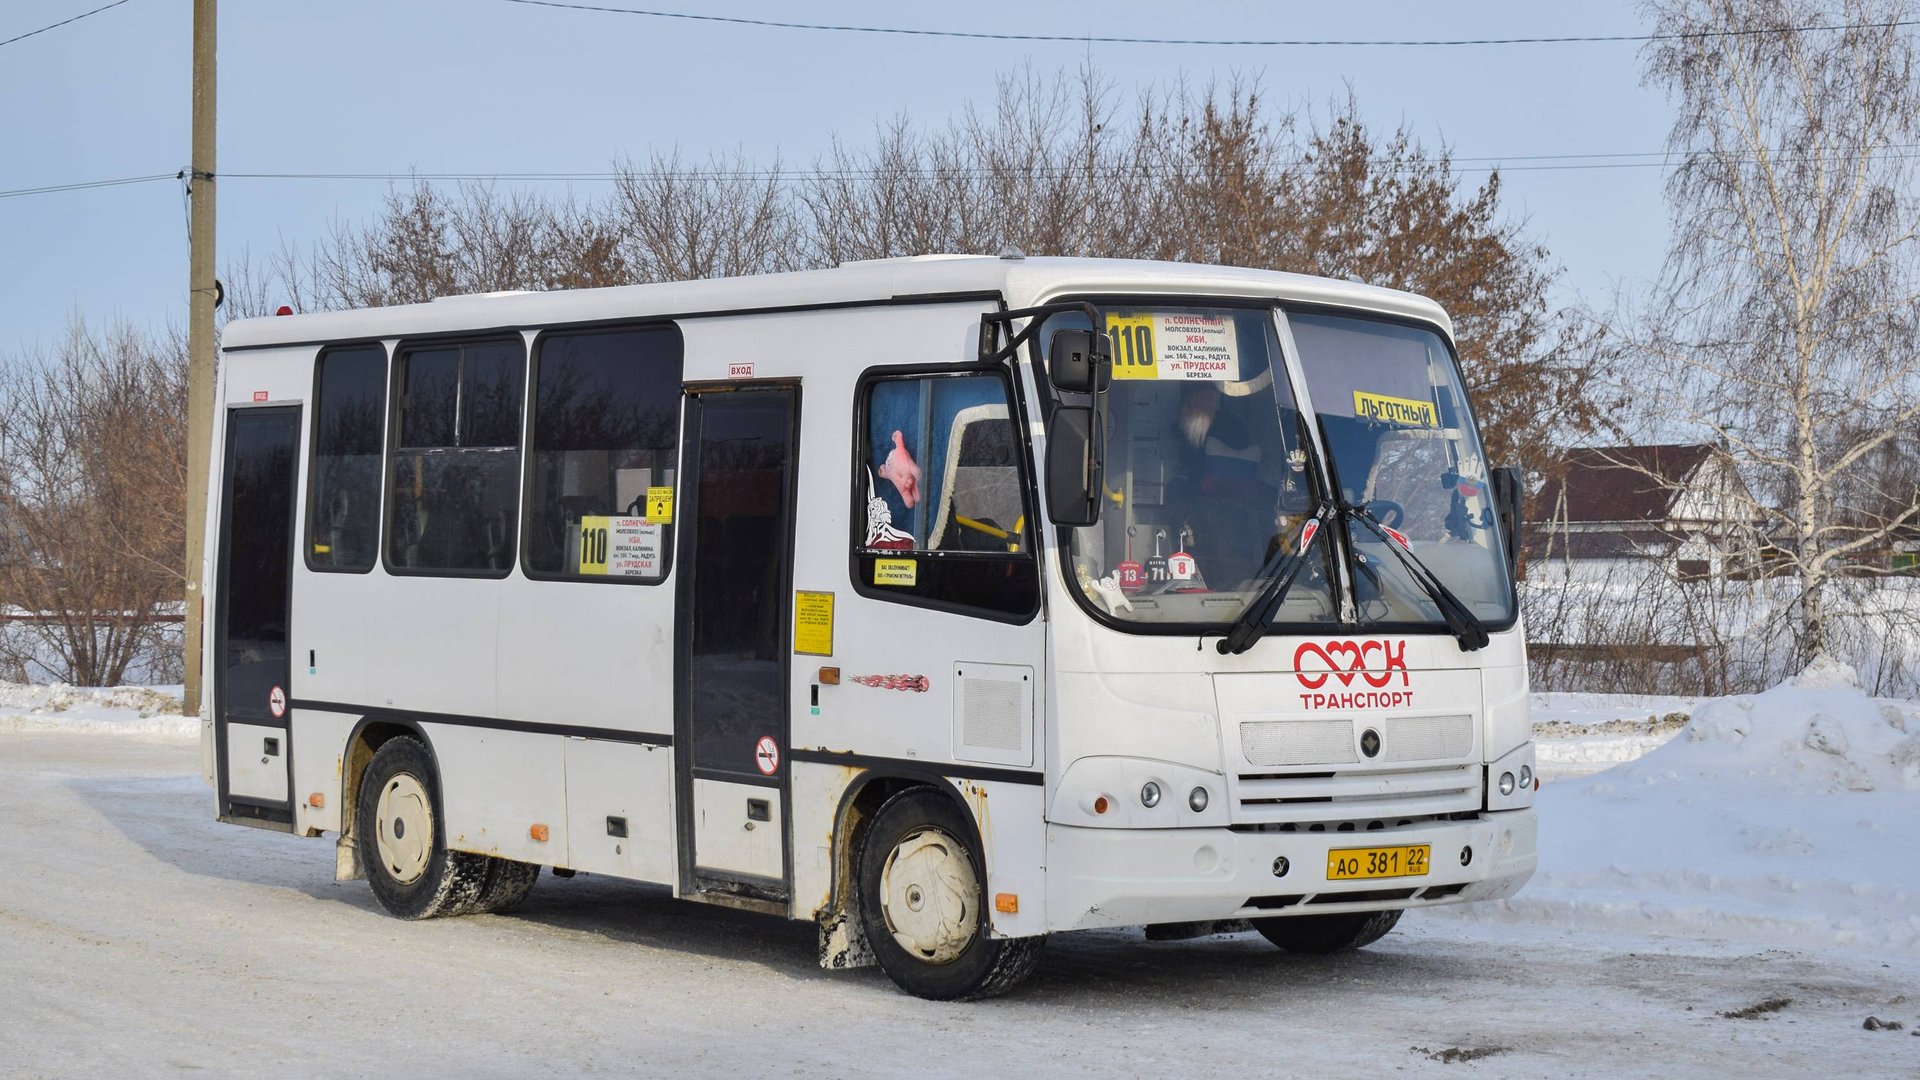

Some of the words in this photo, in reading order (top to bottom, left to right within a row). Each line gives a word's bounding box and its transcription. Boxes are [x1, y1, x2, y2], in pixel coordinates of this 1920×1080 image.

[1109, 325, 1153, 366] 110
[1186, 335, 1207, 344] ЖБИ,
[731, 366, 752, 376] ВХОД
[1171, 363, 1182, 371] ул.
[1183, 361, 1226, 371] ПРУДСКАЯ
[1361, 397, 1431, 424] ЛЬГОТНЫЙ
[582, 528, 607, 564] 110
[1151, 567, 1165, 580] 71
[1177, 561, 1186, 574] 8
[1124, 569, 1137, 582] 13
[1300, 691, 1413, 710] ТРАНСПОРТ
[1336, 858, 1359, 876] АО
[1367, 851, 1399, 874] 381
[1407, 849, 1424, 866] 22
